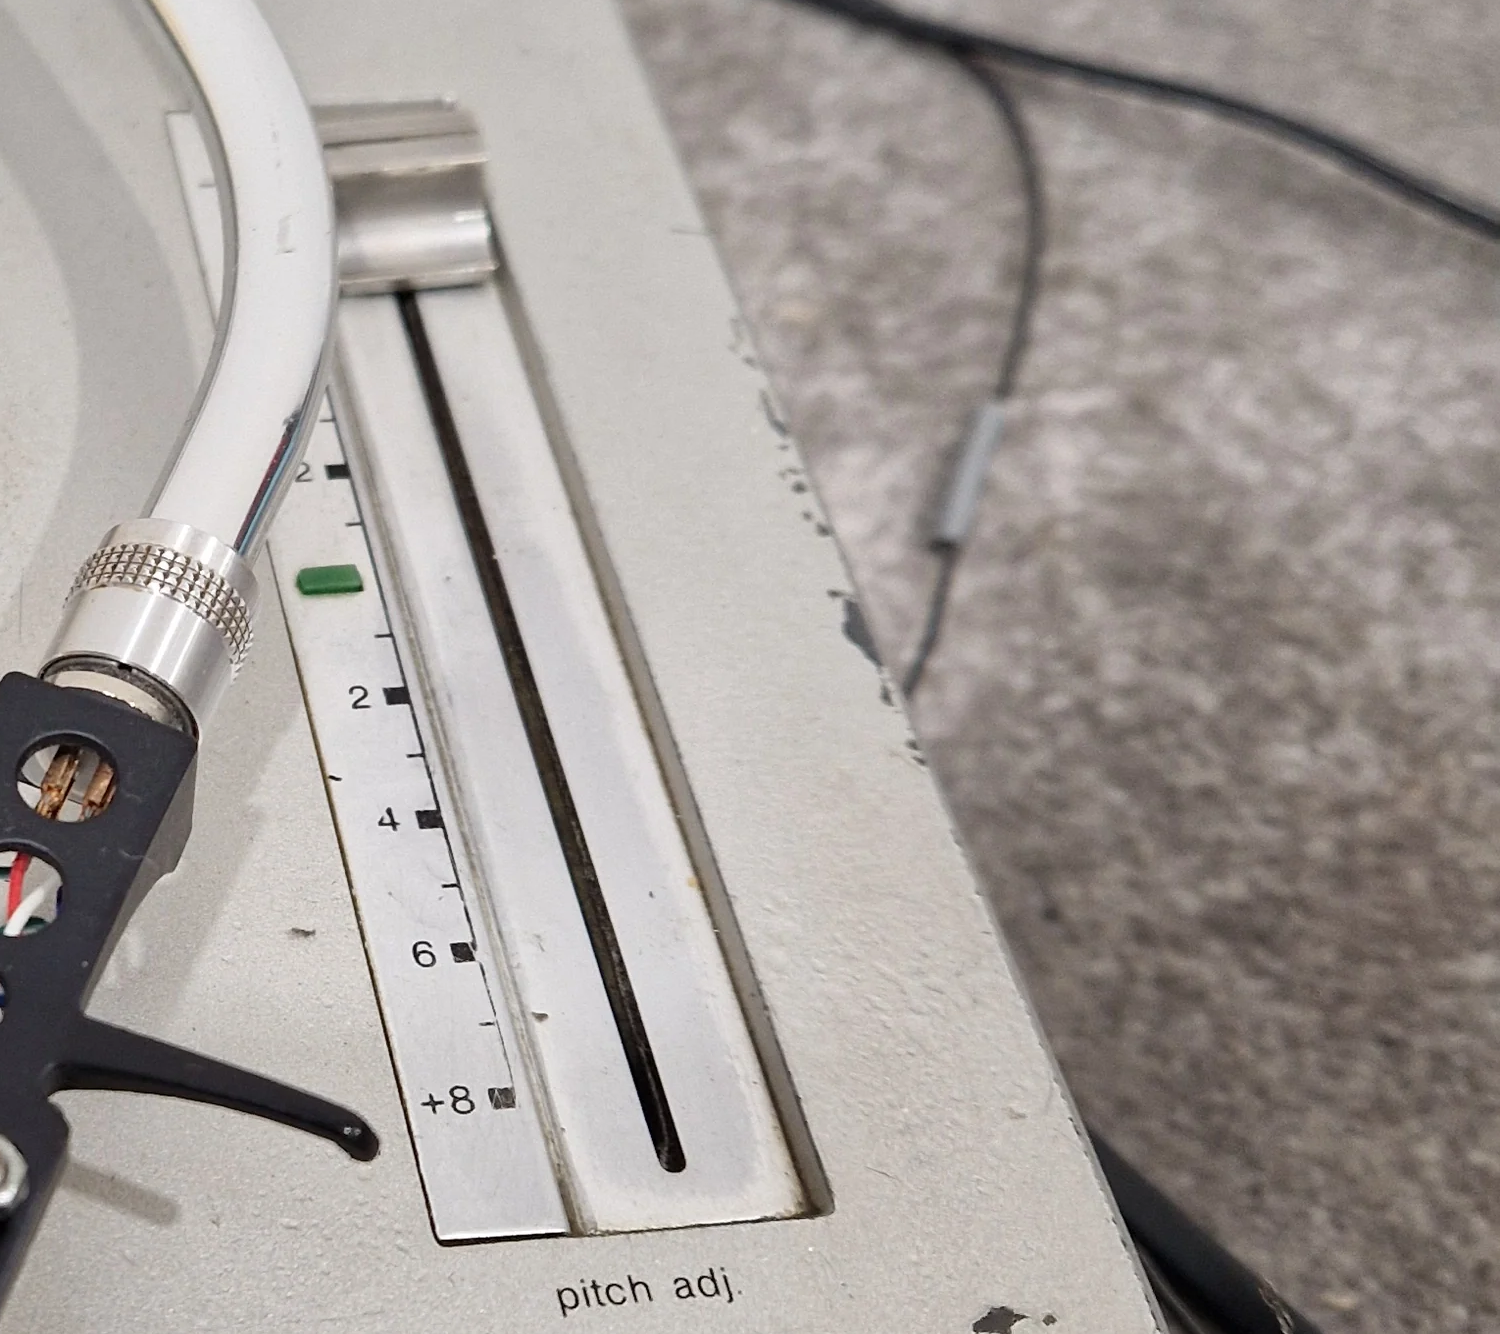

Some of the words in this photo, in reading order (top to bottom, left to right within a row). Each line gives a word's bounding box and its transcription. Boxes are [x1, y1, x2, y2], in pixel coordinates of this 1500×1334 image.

[294, 461, 314, 483] 2
[348, 685, 372, 710] 2
[376, 806, 401, 832] 4
[411, 940, 437, 968] 6
[420, 1085, 476, 1115] +8
[555, 1272, 654, 1317] pitch
[673, 1267, 745, 1304] adj.
